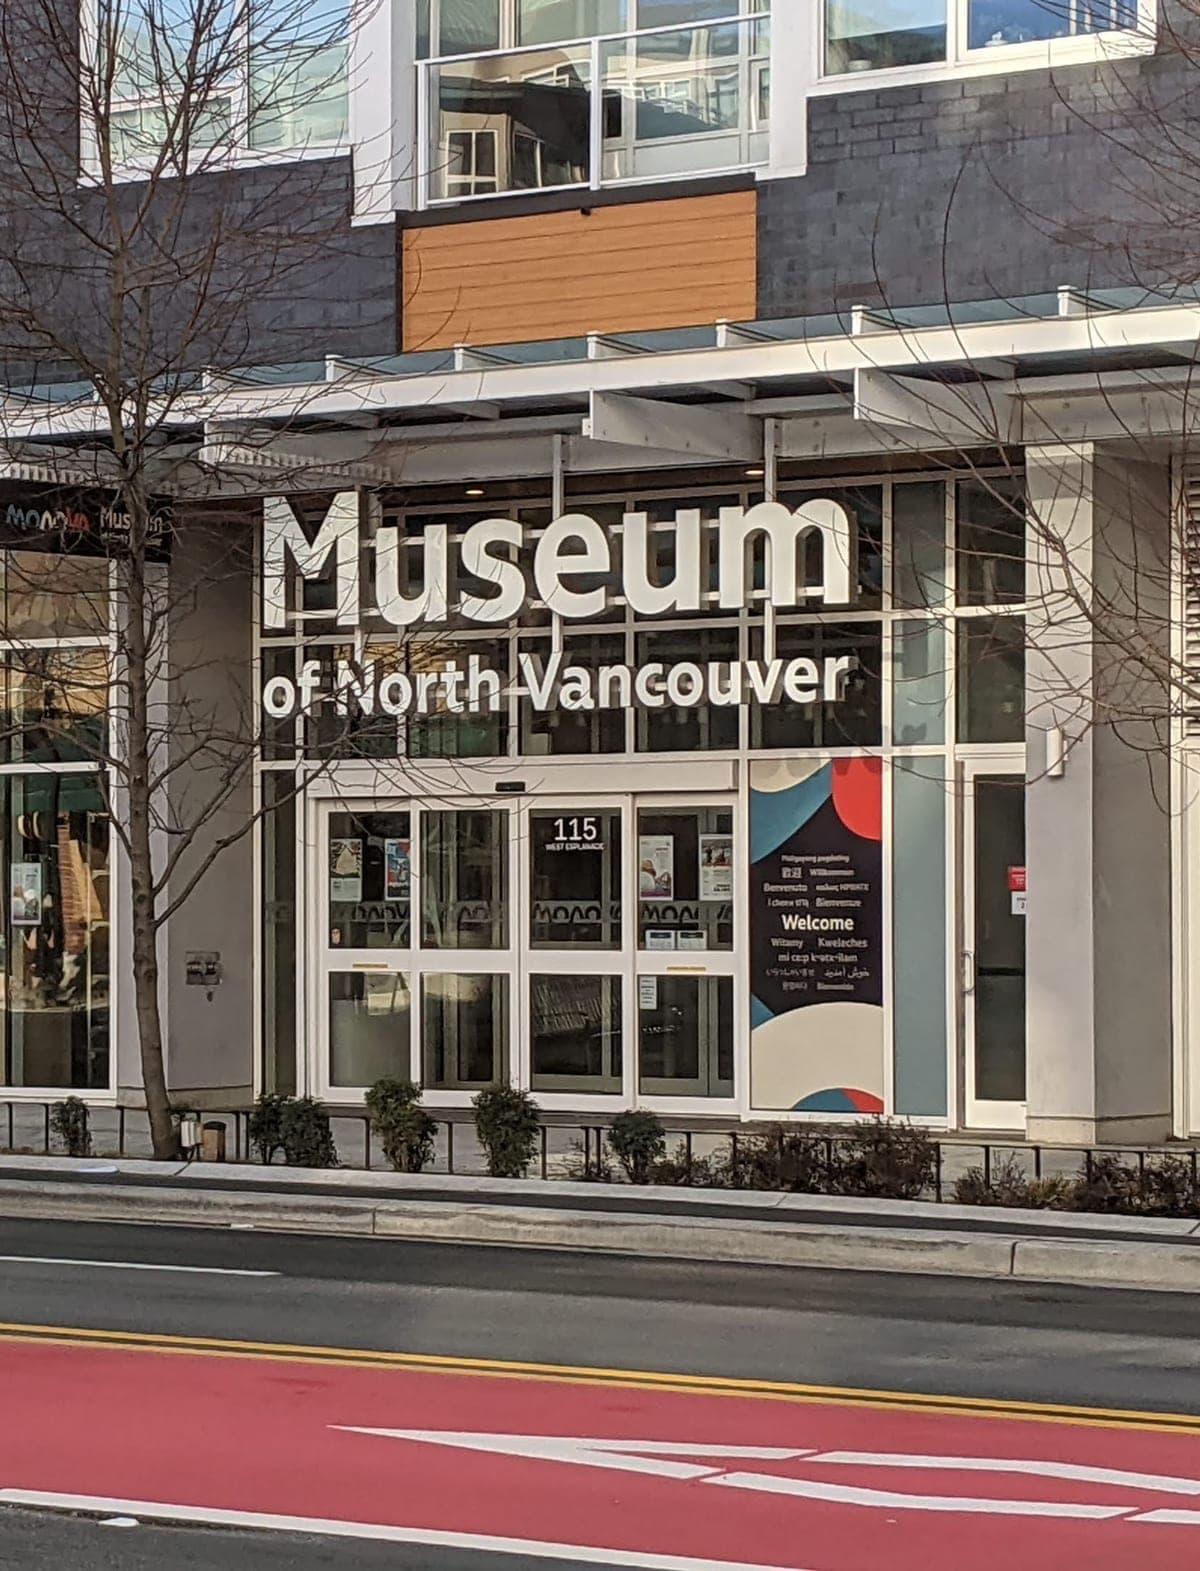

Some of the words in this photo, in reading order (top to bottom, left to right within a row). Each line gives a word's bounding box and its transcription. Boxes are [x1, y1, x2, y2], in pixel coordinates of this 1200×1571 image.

[262, 490, 852, 630] Museum
[262, 659, 321, 719] of
[336, 654, 500, 716] North
[517, 651, 850, 713] Vancouver
[553, 816, 597, 840] 115
[781, 914, 855, 930] Welcome
